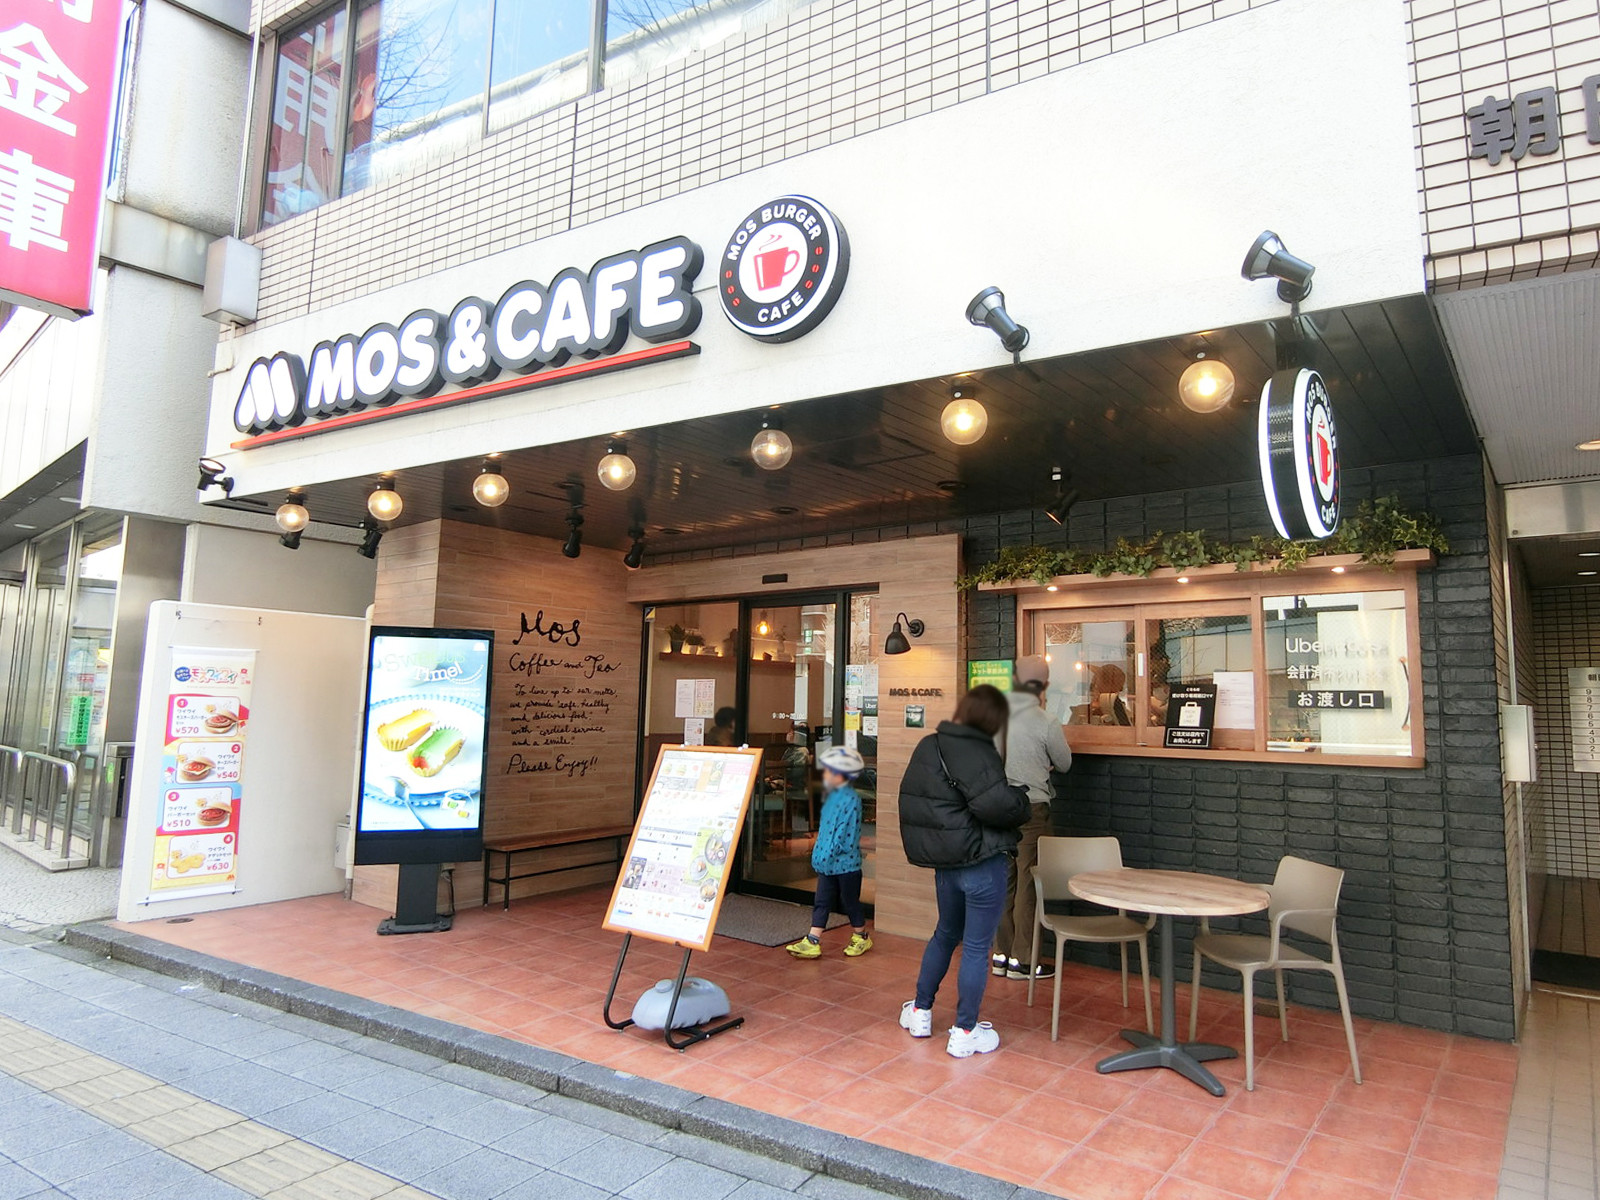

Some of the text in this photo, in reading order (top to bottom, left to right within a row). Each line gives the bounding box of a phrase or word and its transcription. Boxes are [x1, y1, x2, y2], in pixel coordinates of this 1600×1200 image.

[727, 204, 822, 261] MOS BURGER
[757, 291, 805, 322] CAFE
[307, 316, 437, 409] MOS
[447, 303, 486, 376] &
[494, 245, 687, 363] CAFE
[512, 610, 581, 647] Mos
[510, 652, 562, 677] Coffee
[584, 654, 621, 679] Tea
[530, 686, 548, 695] live
[551, 689, 559, 698] up
[889, 688, 942, 696] MOS & CAFE
[1297, 692, 1374, 707] お渡し口
[511, 714, 530, 722] and
[511, 725, 533, 735] with
[506, 754, 599, 777] Please Enjoy!!
[167, 819, 191, 827] ¥510
